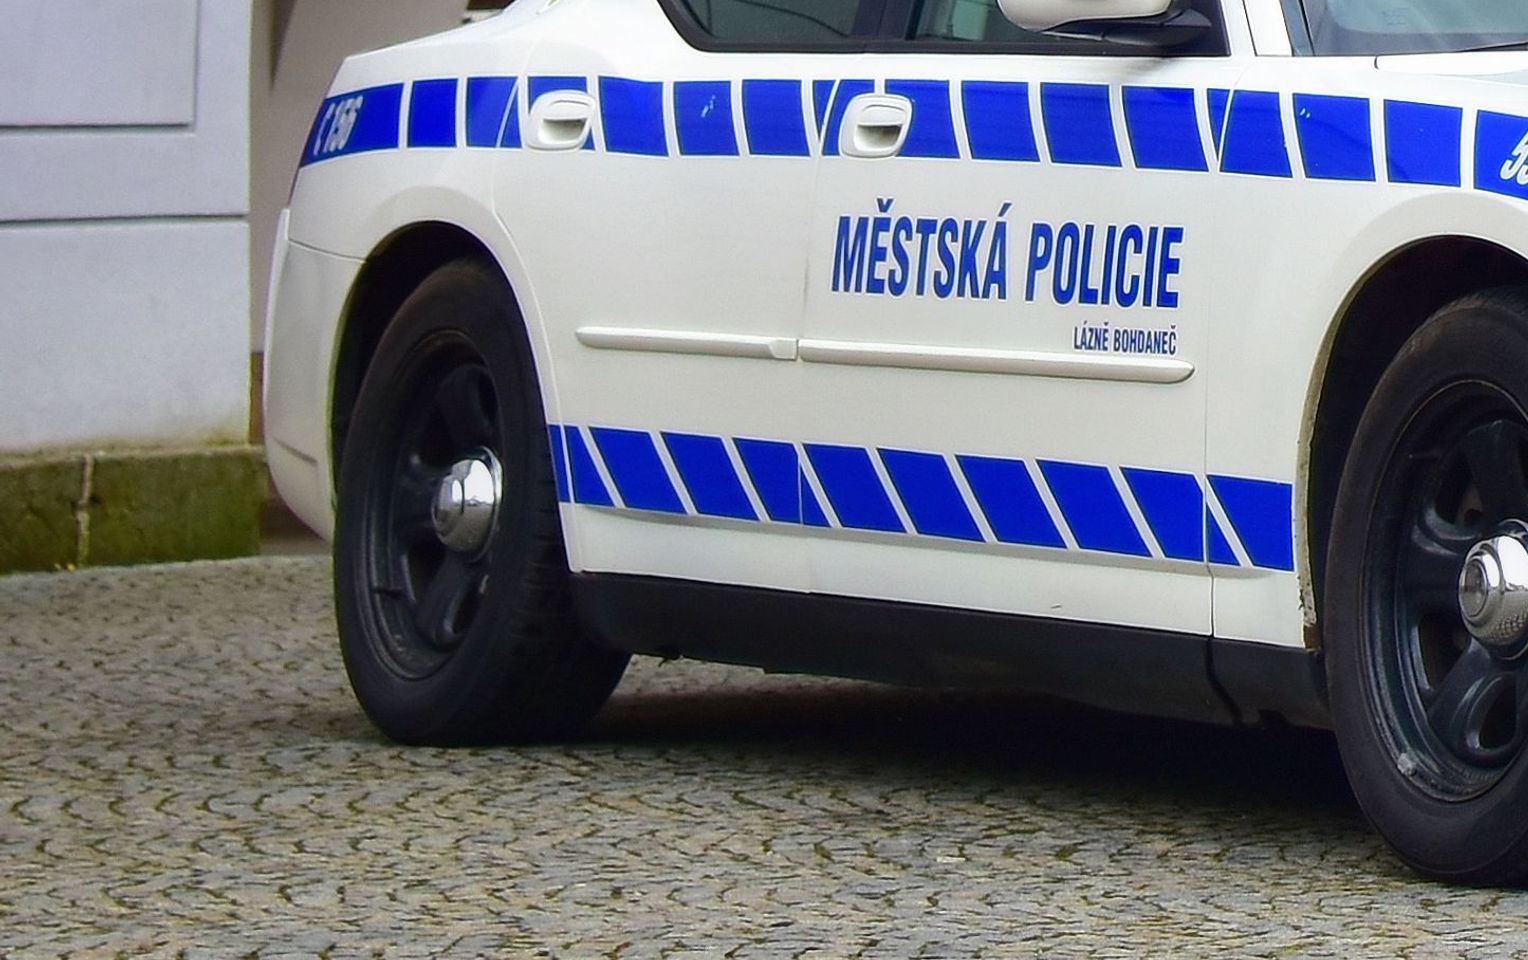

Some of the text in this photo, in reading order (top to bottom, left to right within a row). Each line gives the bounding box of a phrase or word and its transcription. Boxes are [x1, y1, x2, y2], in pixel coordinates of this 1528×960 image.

[832, 198, 1184, 308] MĚSTSKÁ POLICIE
[1074, 322, 1176, 355] LÁZNĚ BOHDANEČ
